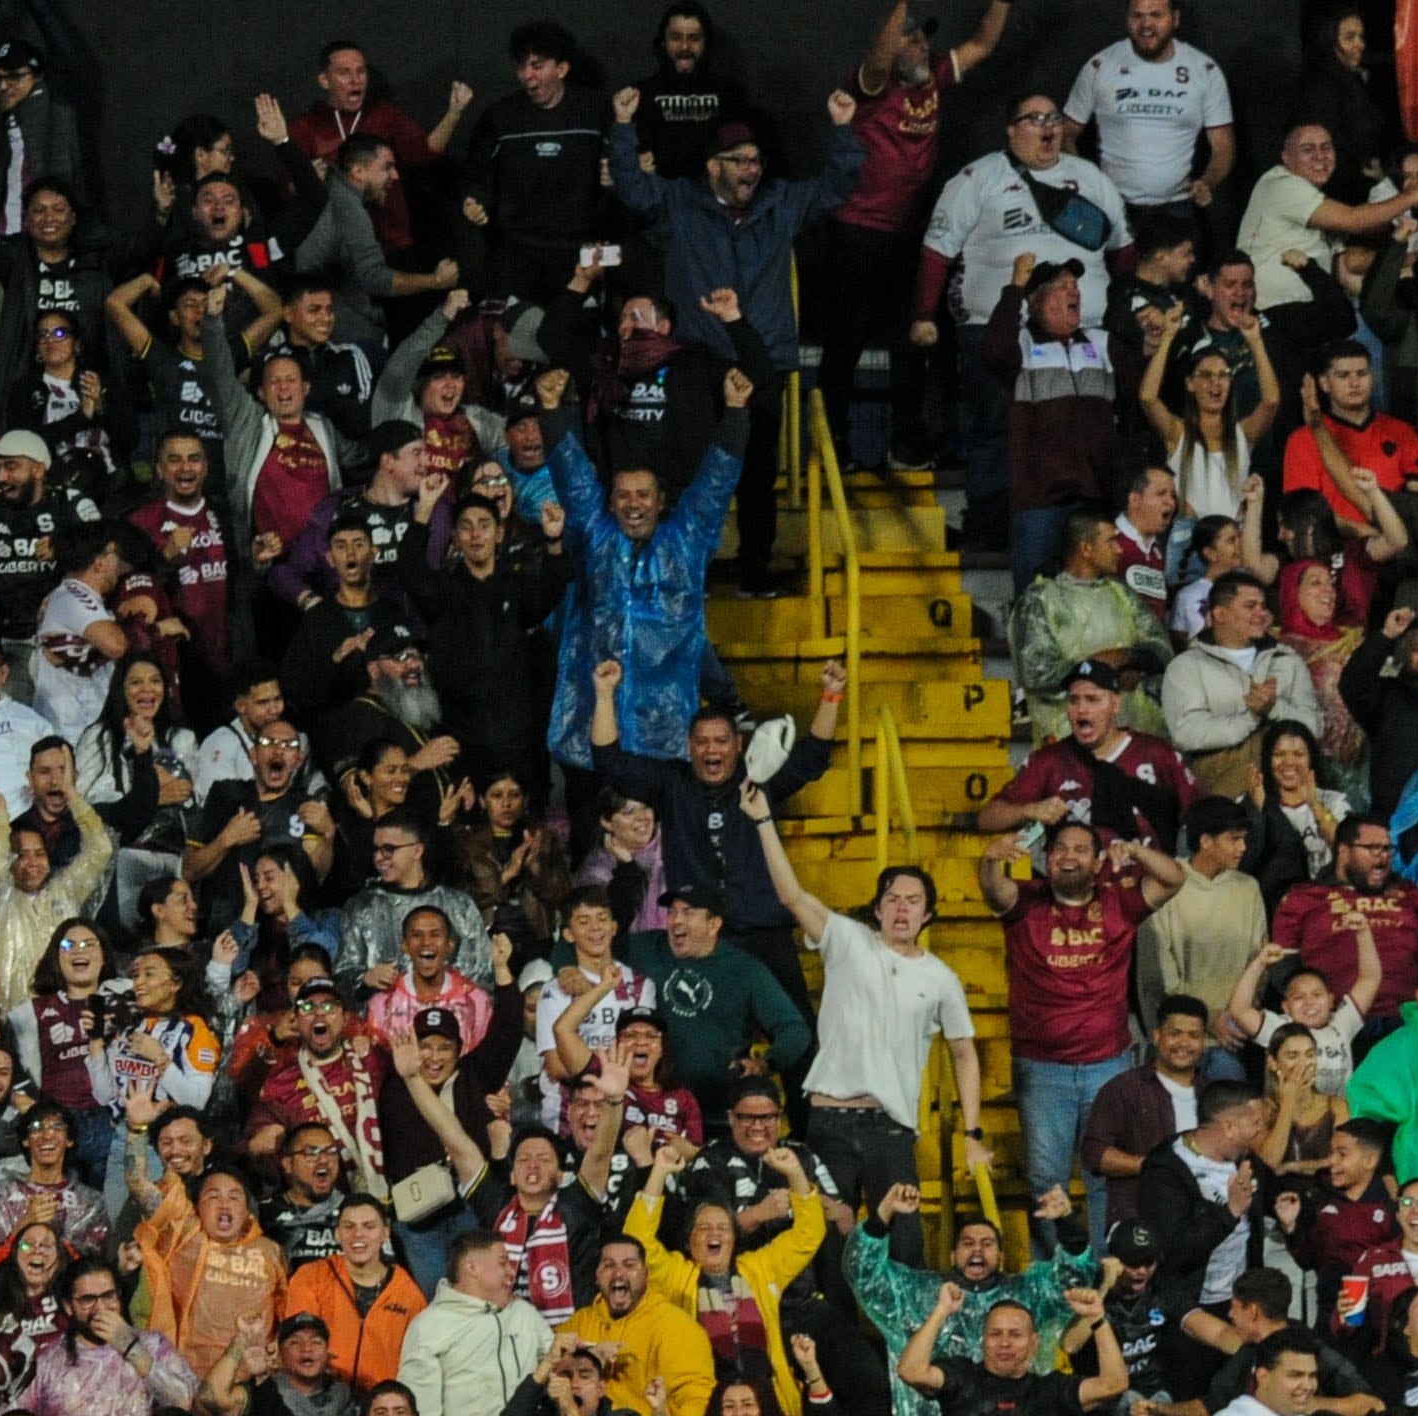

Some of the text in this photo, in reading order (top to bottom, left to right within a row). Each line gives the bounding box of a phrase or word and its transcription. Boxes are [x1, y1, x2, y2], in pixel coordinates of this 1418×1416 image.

[1175, 67, 1188, 84] S
[39, 513, 55, 532] S
[928, 600, 953, 628] Q
[963, 683, 985, 711] P
[965, 772, 988, 802] O
[288, 814, 305, 838] S
[1356, 898, 1402, 912] BAC
[1068, 928, 1104, 947] BAC
[427, 1011, 441, 1026] S
[664, 1098, 677, 1115] S
[538, 1267, 555, 1293] S
[1150, 1306, 1165, 1326] S
